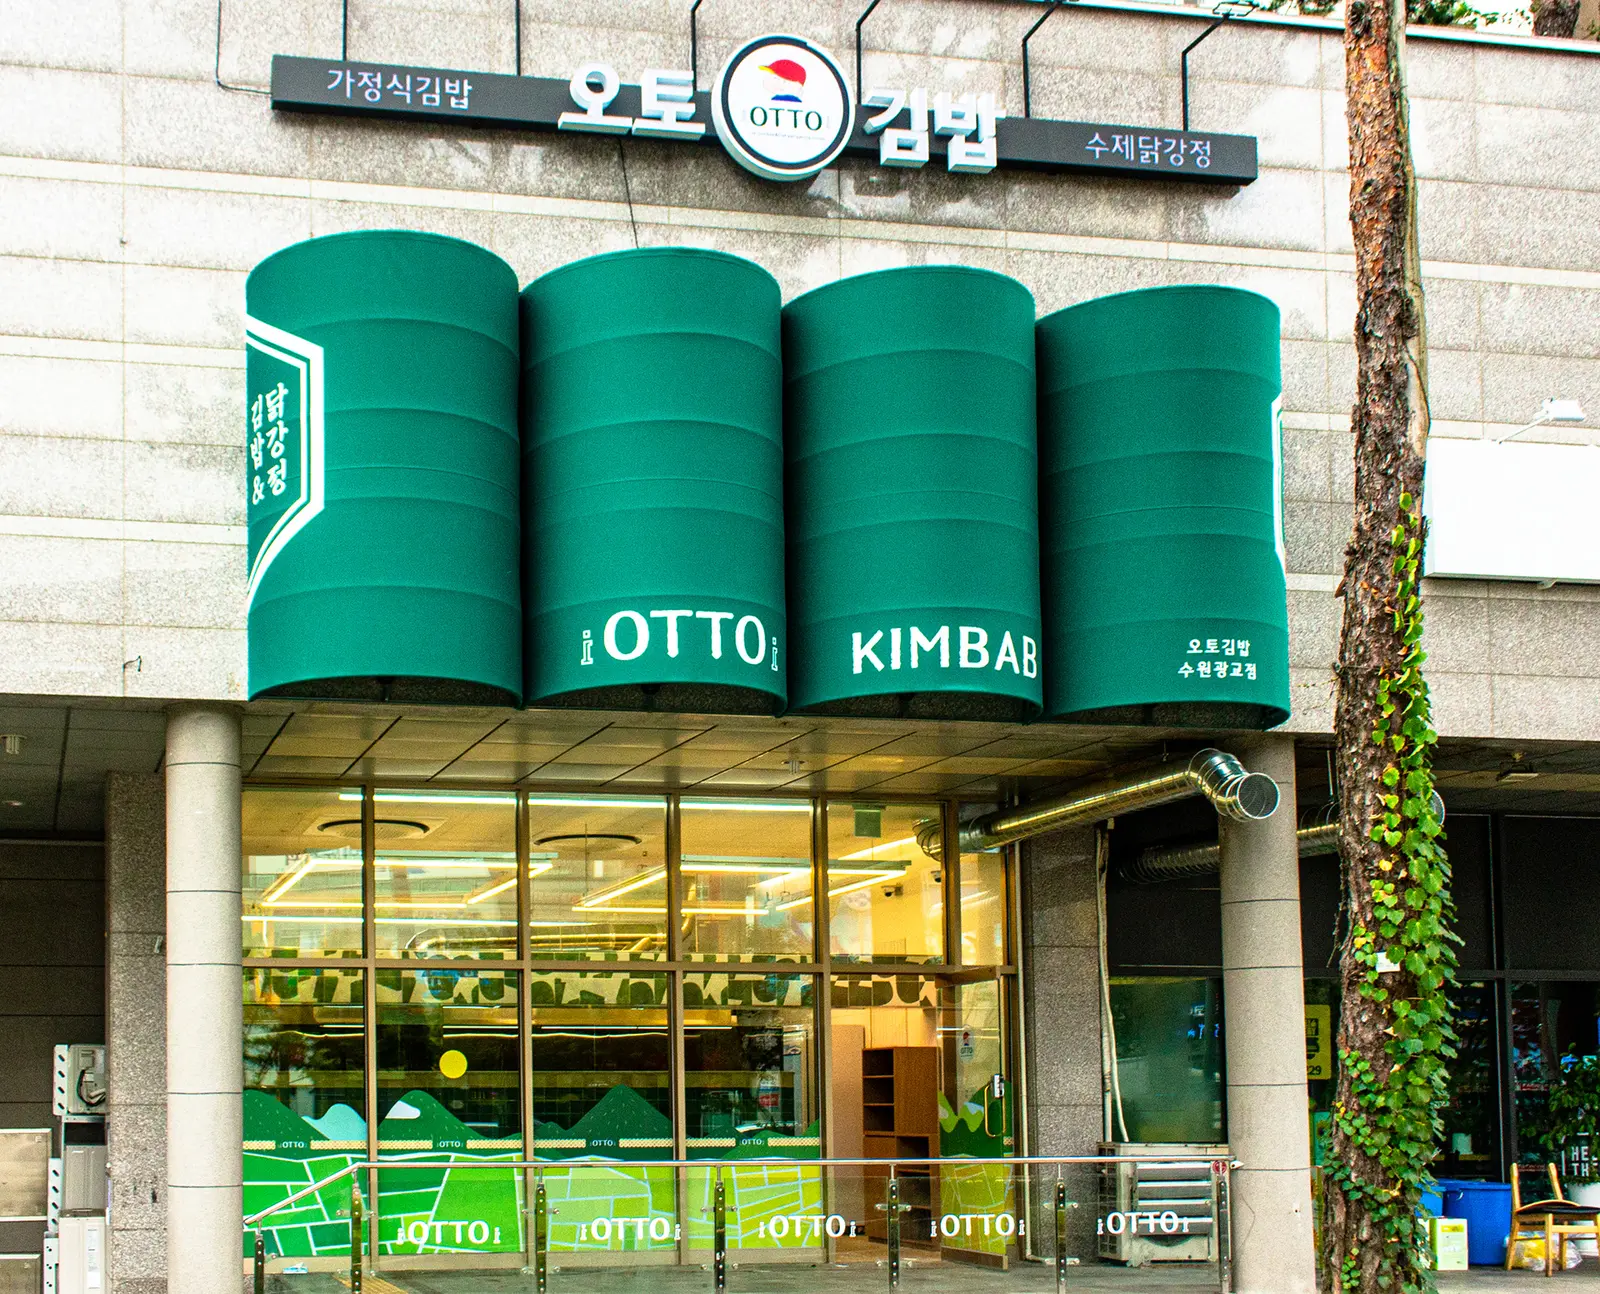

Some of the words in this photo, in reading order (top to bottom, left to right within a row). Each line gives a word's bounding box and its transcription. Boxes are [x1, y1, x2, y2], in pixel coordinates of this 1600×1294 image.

[328, 69, 473, 111] 가정식김밥
[557, 62, 706, 141] 오토
[860, 87, 1007, 174] 김밥
[1085, 131, 1212, 169] 수제닭강정
[851, 625, 1038, 679] KIMBAB
[1186, 639, 1252, 658] 오토김밥
